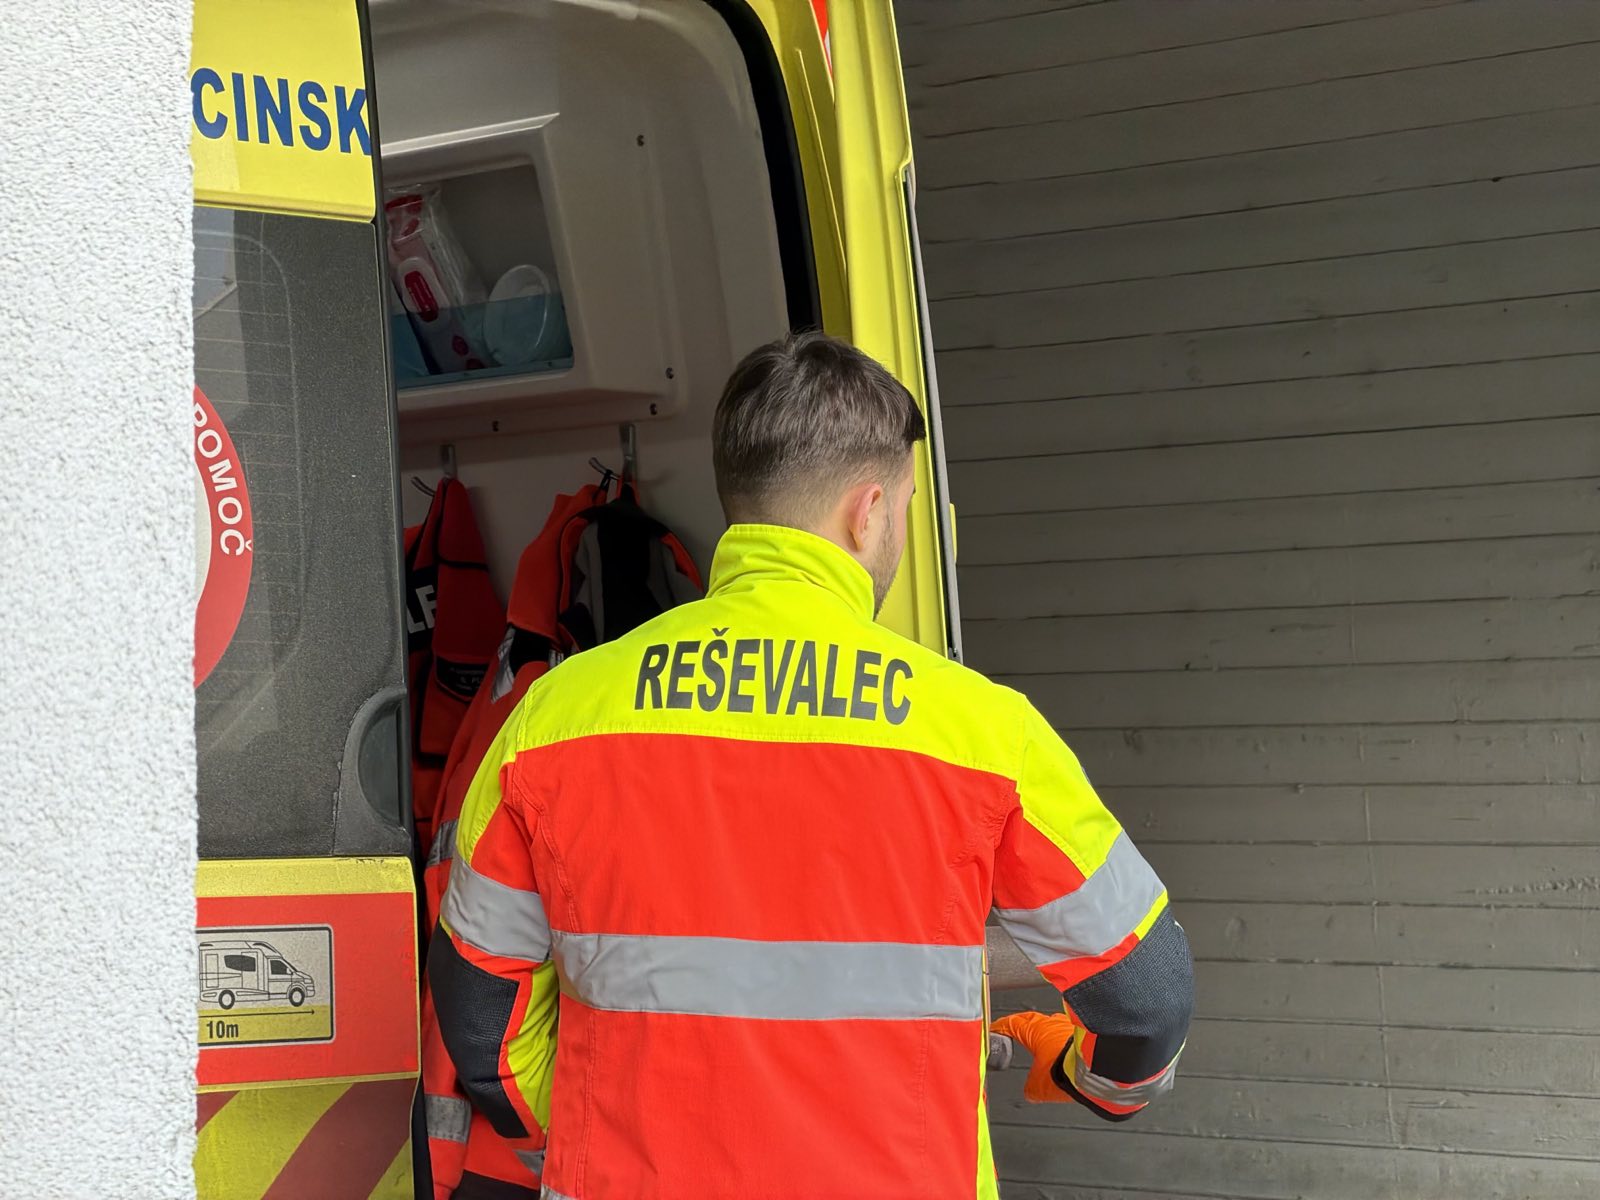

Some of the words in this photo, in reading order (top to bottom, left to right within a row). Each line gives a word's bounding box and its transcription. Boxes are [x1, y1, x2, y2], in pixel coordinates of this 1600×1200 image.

[191, 67, 372, 156] CINSK
[194, 403, 252, 556] POMOČ
[634, 627, 914, 725] REŠEVALEC
[206, 1020, 239, 1039] 10m
